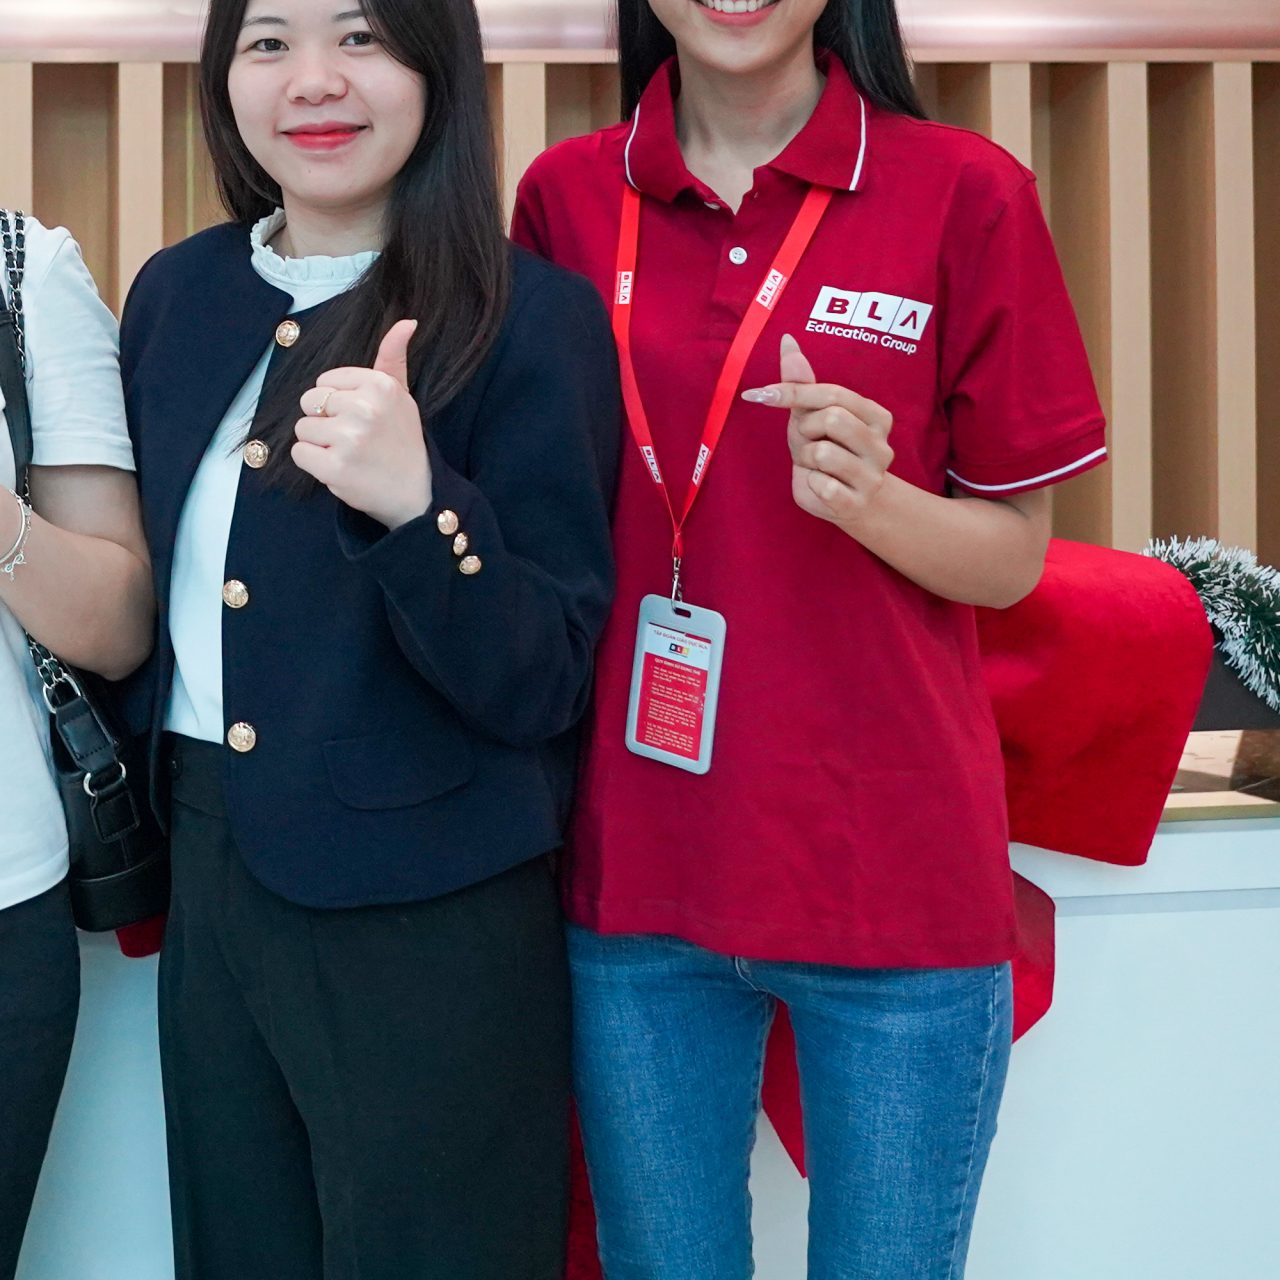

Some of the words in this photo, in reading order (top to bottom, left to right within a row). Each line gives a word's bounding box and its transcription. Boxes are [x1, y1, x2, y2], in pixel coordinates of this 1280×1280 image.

[826, 297, 919, 330] BLA
[805, 320, 878, 345] Education
[880, 335, 918, 355] Group
